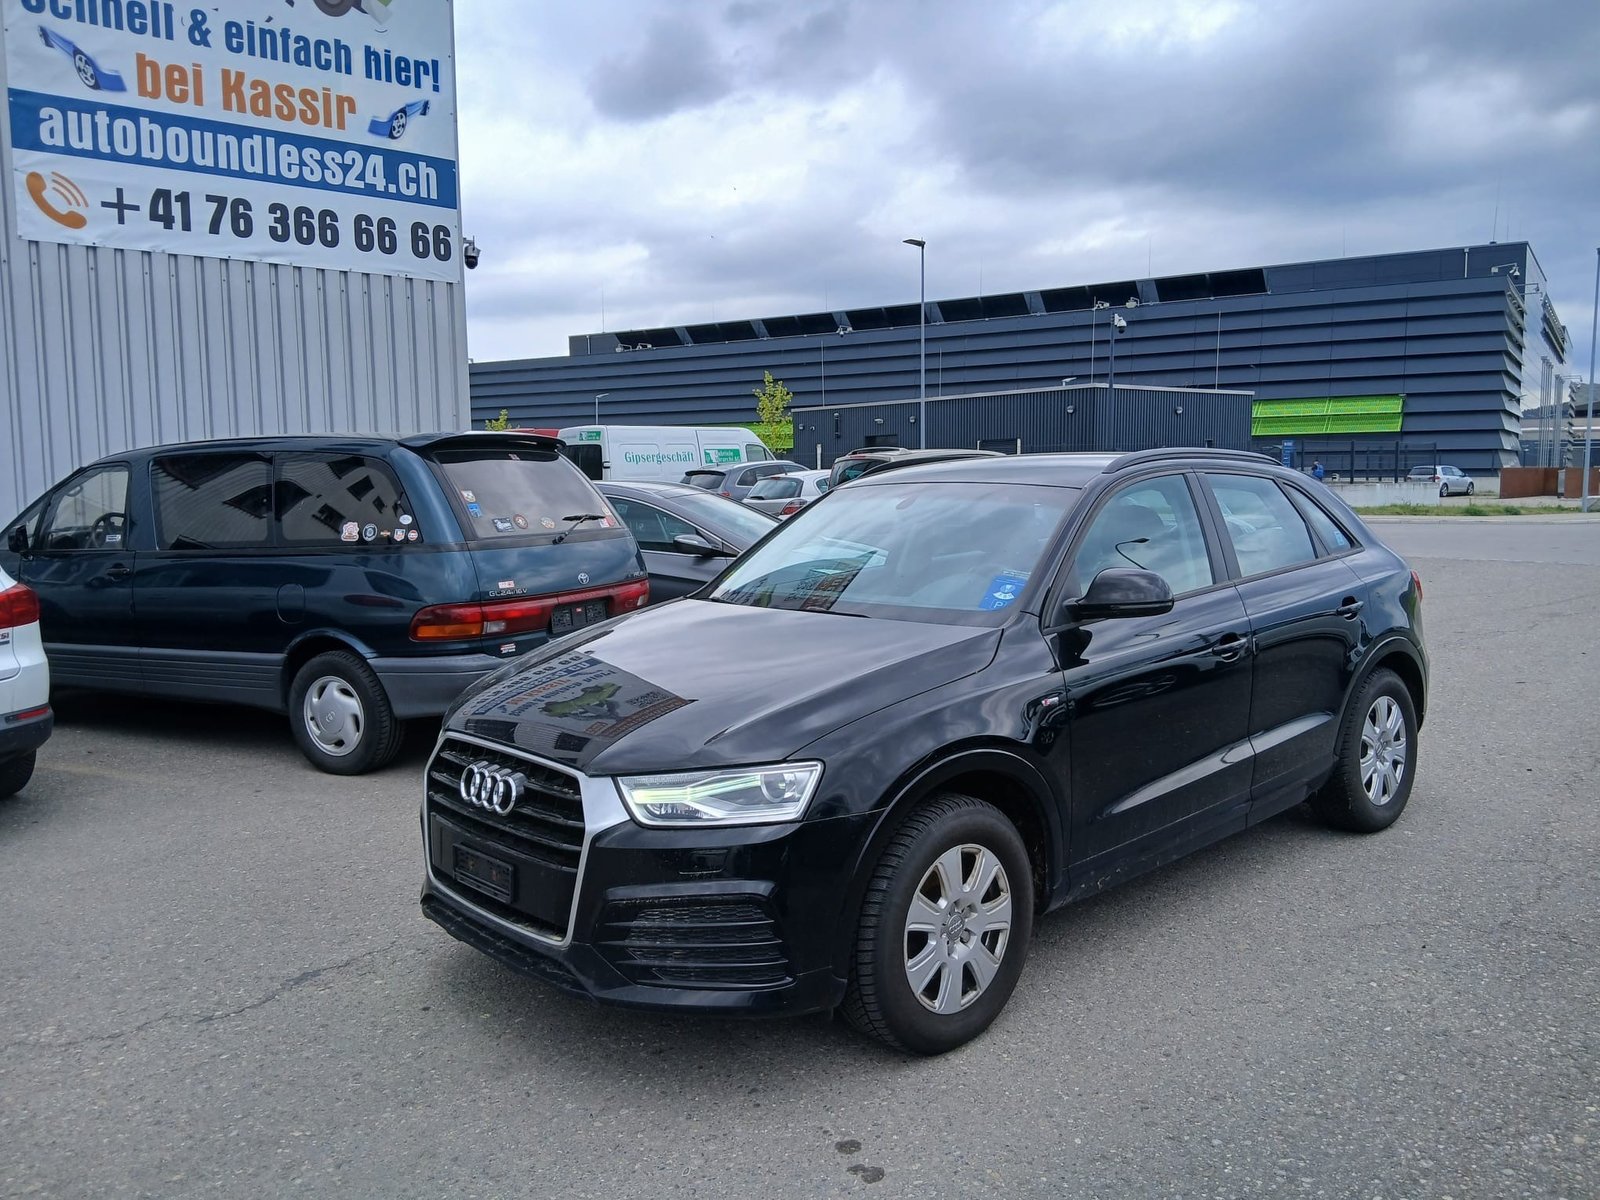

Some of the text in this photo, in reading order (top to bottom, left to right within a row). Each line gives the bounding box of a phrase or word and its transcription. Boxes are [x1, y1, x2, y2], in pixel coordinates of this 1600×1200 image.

[188, 9, 212, 48] &
[225, 20, 352, 75] einfach
[365, 44, 440, 93] hier!
[135, 53, 356, 131] bei Kassir
[39, 106, 438, 200] autoboundless24.ch
[205, 194, 253, 238] 76
[268, 202, 340, 248] 366
[354, 214, 397, 255] 66
[411, 221, 452, 262] 66
[624, 450, 694, 465] Gipsergeschäft
[0, 632, 9, 640] SI
